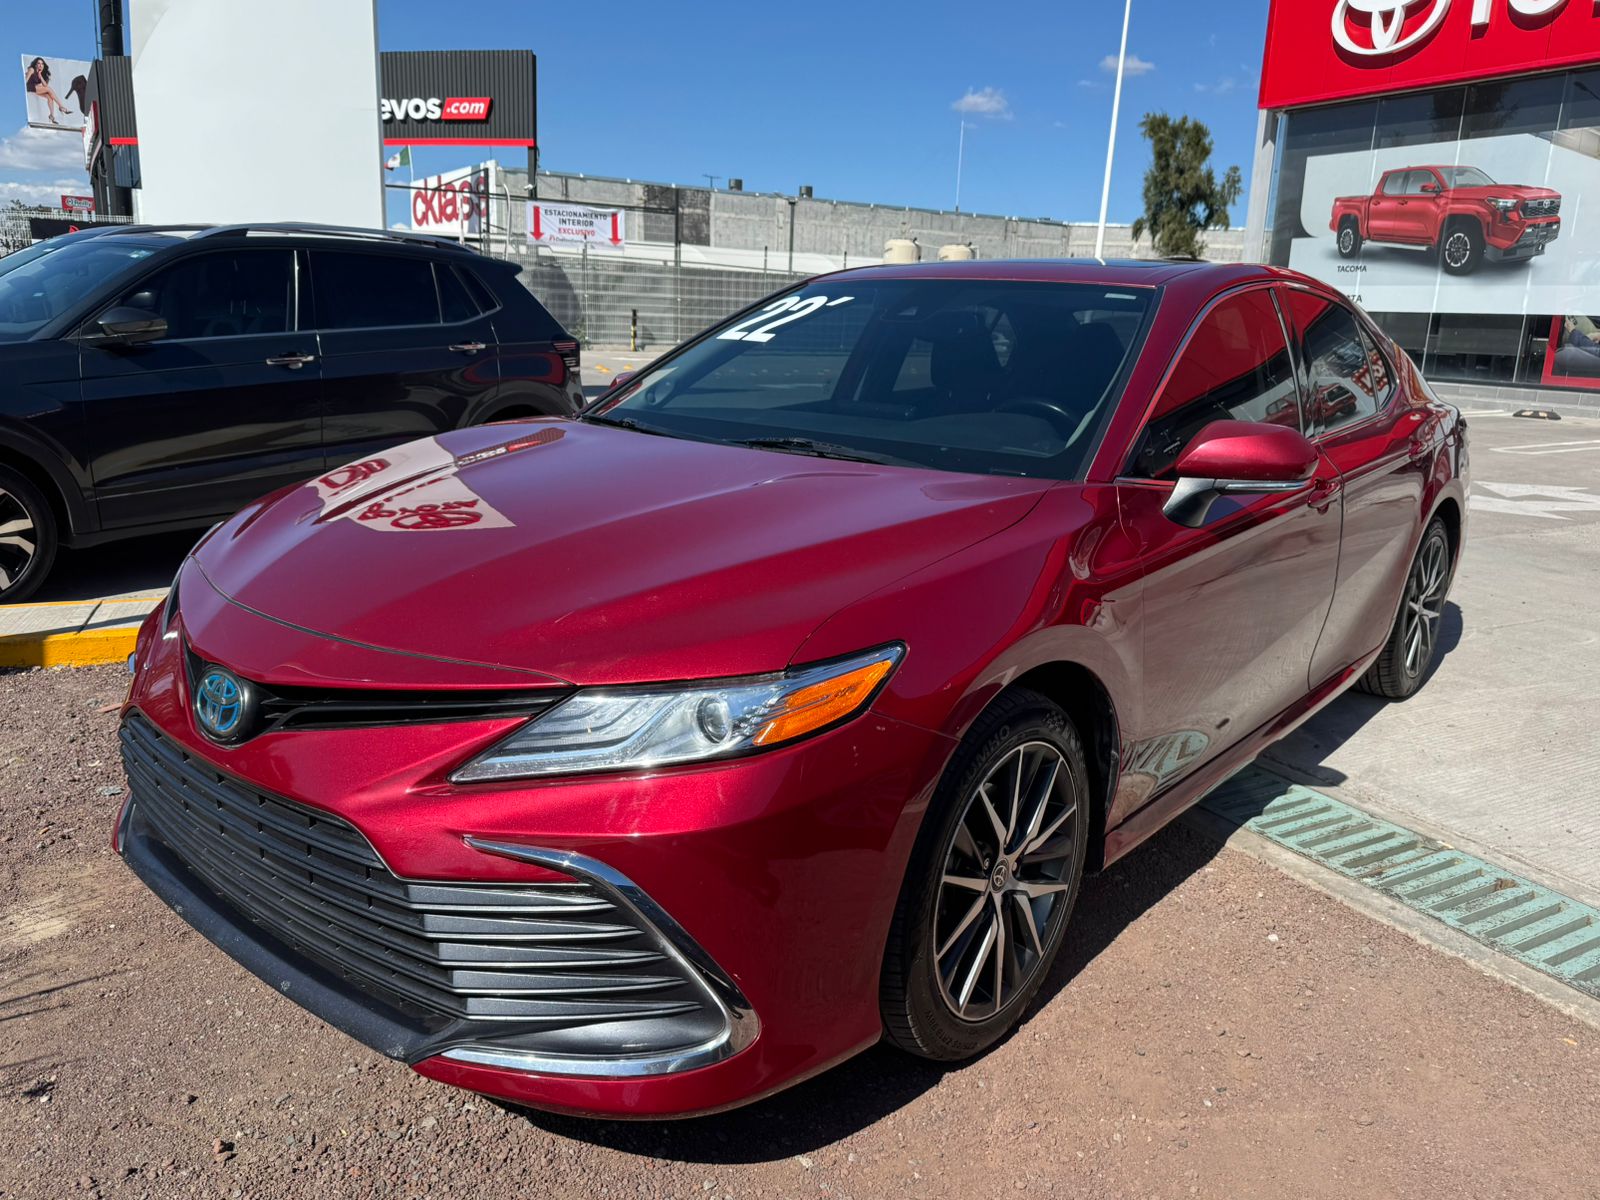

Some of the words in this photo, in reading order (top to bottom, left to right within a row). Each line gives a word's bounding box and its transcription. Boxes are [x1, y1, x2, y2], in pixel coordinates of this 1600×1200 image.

[446, 102, 485, 114] .com
[544, 209, 608, 220] ESTACIONAMIENTO
[559, 218, 594, 227] INTERIOR
[558, 228, 596, 237] EXCLUSIVO
[1347, 295, 1362, 303] TA
